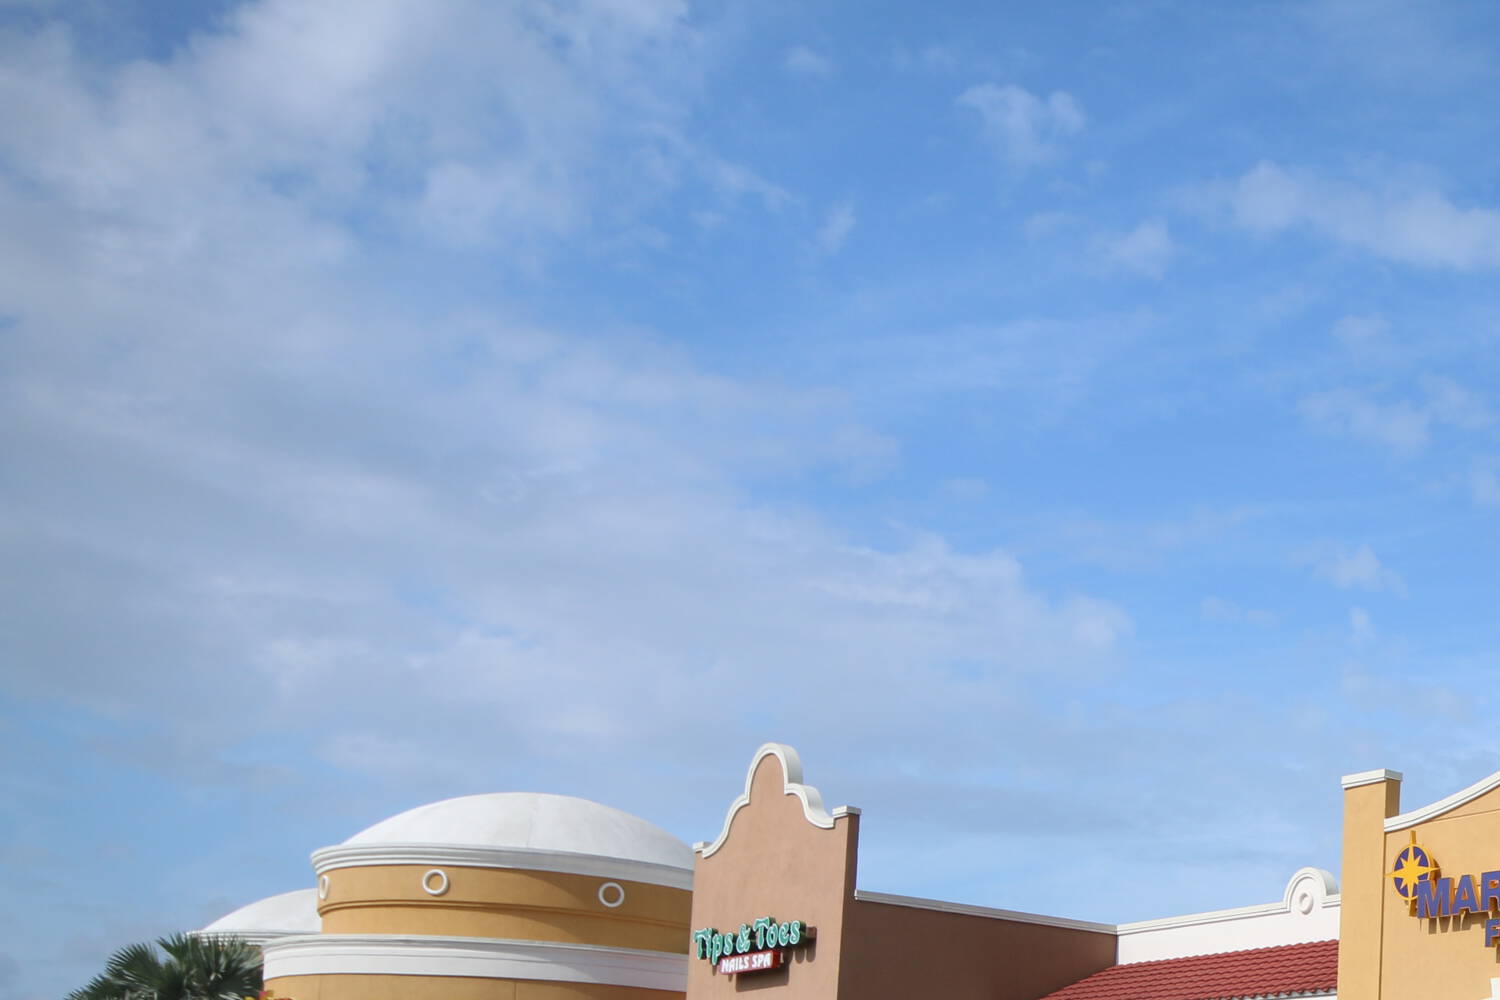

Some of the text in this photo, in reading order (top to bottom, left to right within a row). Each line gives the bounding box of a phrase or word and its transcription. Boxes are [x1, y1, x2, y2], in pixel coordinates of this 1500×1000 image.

[693, 916, 801, 966] Tips & Toes
[721, 952, 773, 973] NAILS SPA
